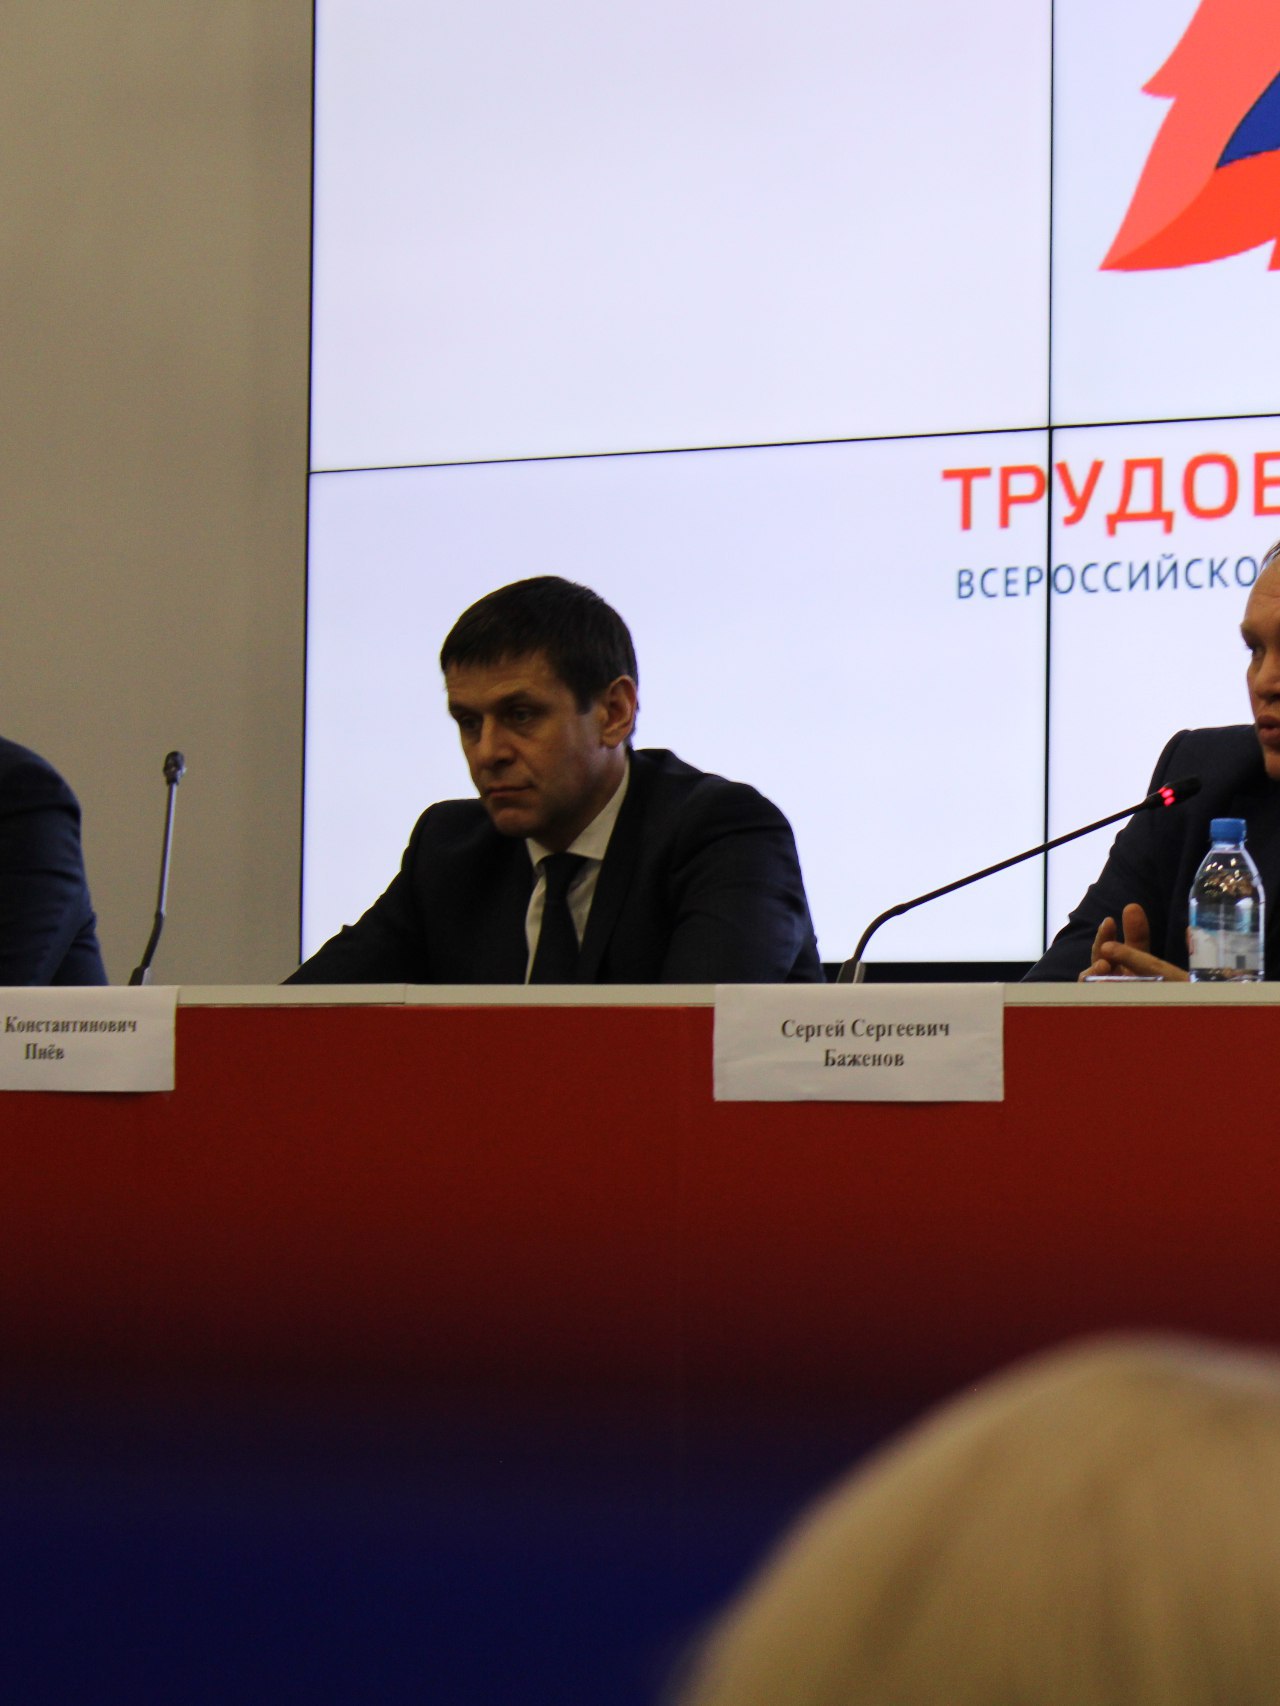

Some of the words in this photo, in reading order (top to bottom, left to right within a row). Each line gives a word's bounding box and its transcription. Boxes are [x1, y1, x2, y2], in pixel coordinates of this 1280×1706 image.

[957, 553, 1258, 599] ВСЕРОССИЙСКО
[4, 1015, 137, 1033] Константинович
[781, 1018, 845, 1042] Сергей
[851, 1018, 950, 1042] Сергеевич
[25, 1042, 65, 1060] Пнёв
[824, 1048, 905, 1067] Баженов
